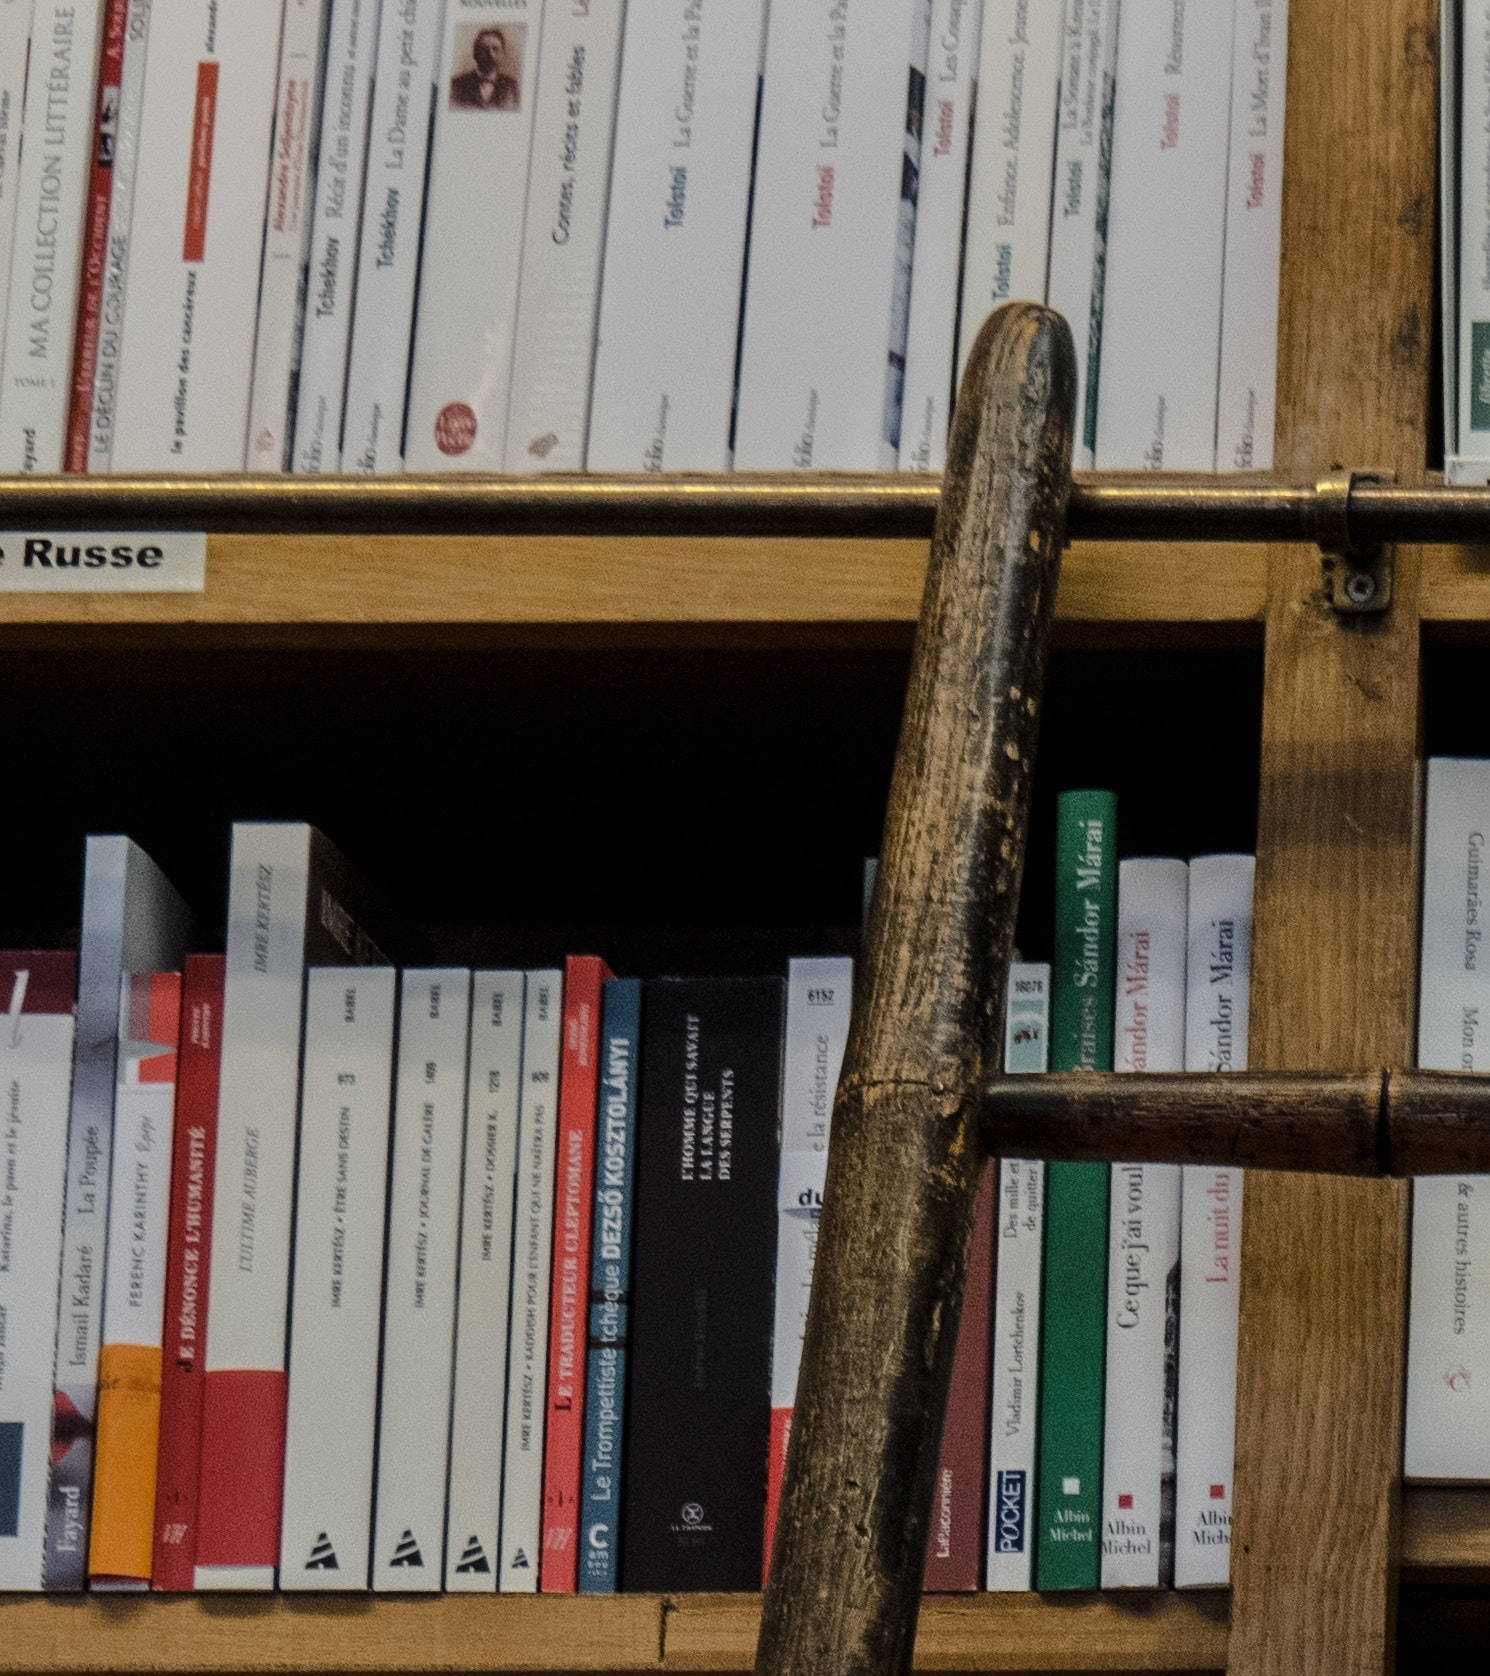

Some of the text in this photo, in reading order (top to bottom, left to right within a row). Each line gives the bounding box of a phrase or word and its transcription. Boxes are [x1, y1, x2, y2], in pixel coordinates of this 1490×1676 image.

[27, 7, 75, 360] MA COLLECTION LITTÉRAIRE
[315, 237, 341, 318] Tchekhov
[176, 348, 191, 375] des
[173, 378, 187, 437] pavillon
[22, 537, 165, 568] Russe
[1073, 819, 1106, 988] Sándor Márai
[238, 864, 274, 1274] L'ULTIME AUBERGE IMRE KERTÉSZ
[600, 1038, 630, 1187] KOSZTOLÁNYI
[67, 1125, 103, 1367] Ismail Kadaré La Poupée
[128, 1162, 148, 1308] FERENC KARINTHY
[596, 1264, 625, 1343] tchèque
[592, 1348, 621, 1470] Trompettiste
[1004, 1376, 1023, 1438] Vladimir
[591, 1477, 612, 1501] Le
[999, 1470, 1025, 1553] POCKET
